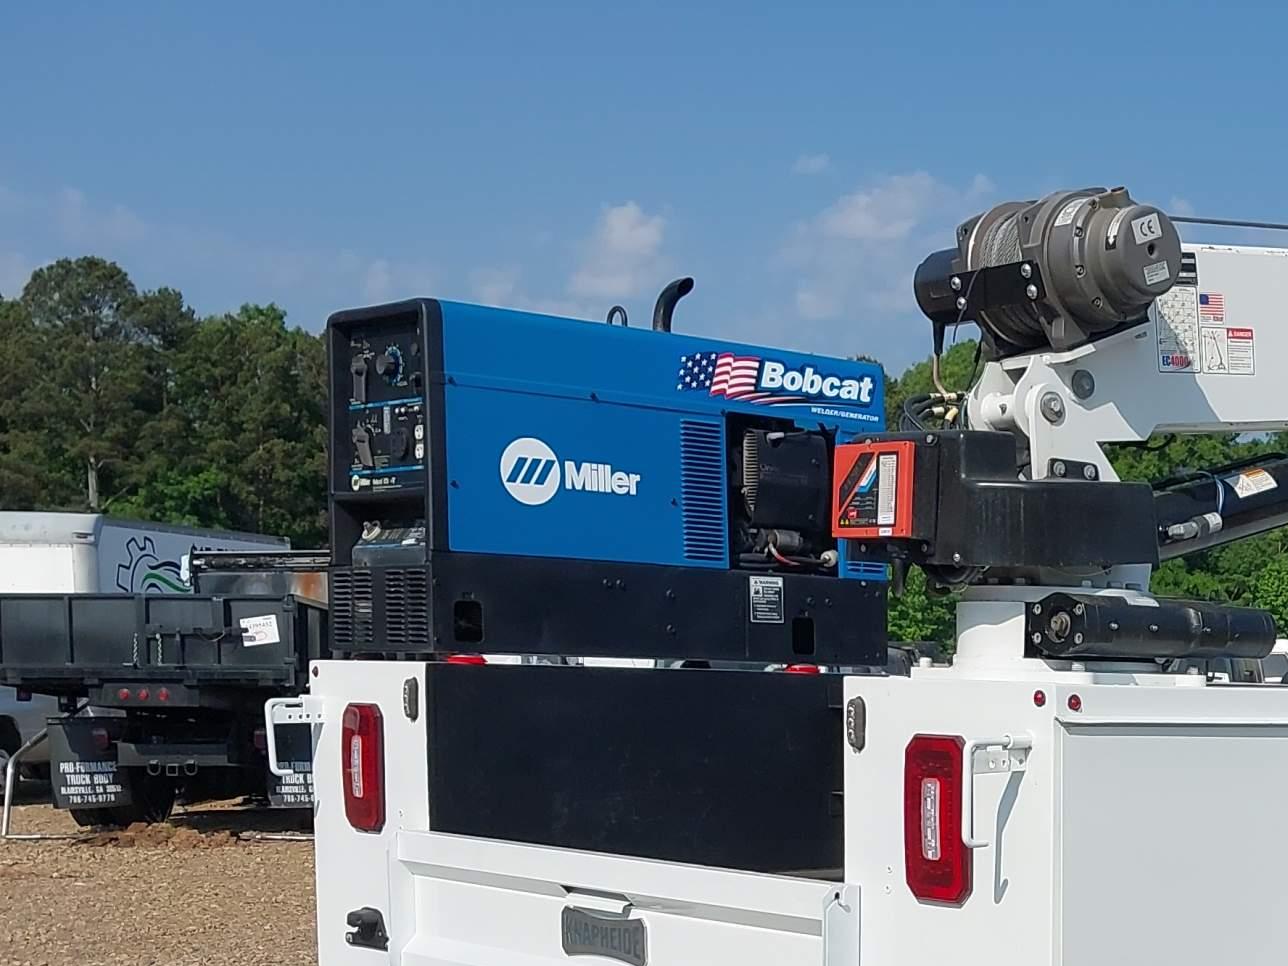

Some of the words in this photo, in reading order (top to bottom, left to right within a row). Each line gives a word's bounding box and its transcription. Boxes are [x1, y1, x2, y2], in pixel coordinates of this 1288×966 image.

[761, 361, 873, 402] Bobcat
[811, 407, 879, 422] WELDER/GENERATOR
[564, 460, 641, 496] Miller
[66, 774, 91, 785] TRUCK
[565, 914, 641, 959] KNAPHEIDE
